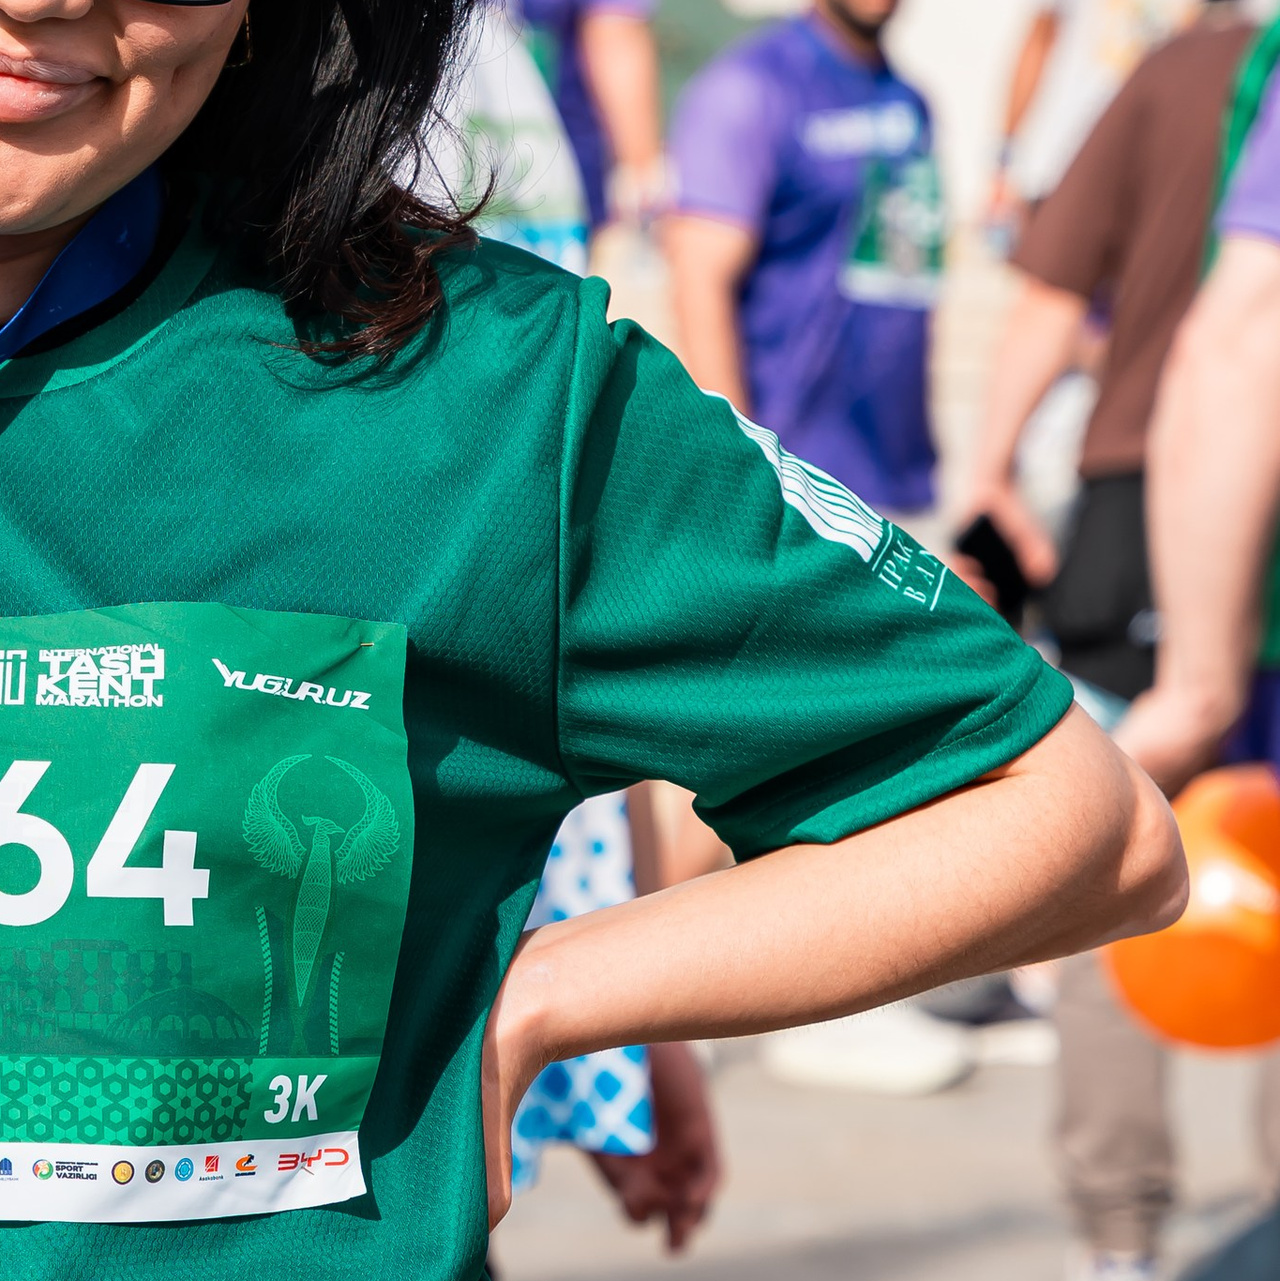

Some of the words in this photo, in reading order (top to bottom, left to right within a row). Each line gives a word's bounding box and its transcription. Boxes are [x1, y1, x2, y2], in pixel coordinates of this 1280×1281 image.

[39, 643, 160, 658] INTERNATIONAL
[39, 648, 164, 680] TASH
[37, 673, 155, 698] KENT
[36, 694, 163, 707] MARATHON
[263, 1074, 328, 1124] 3K
[277, 1148, 349, 1171] BYD
